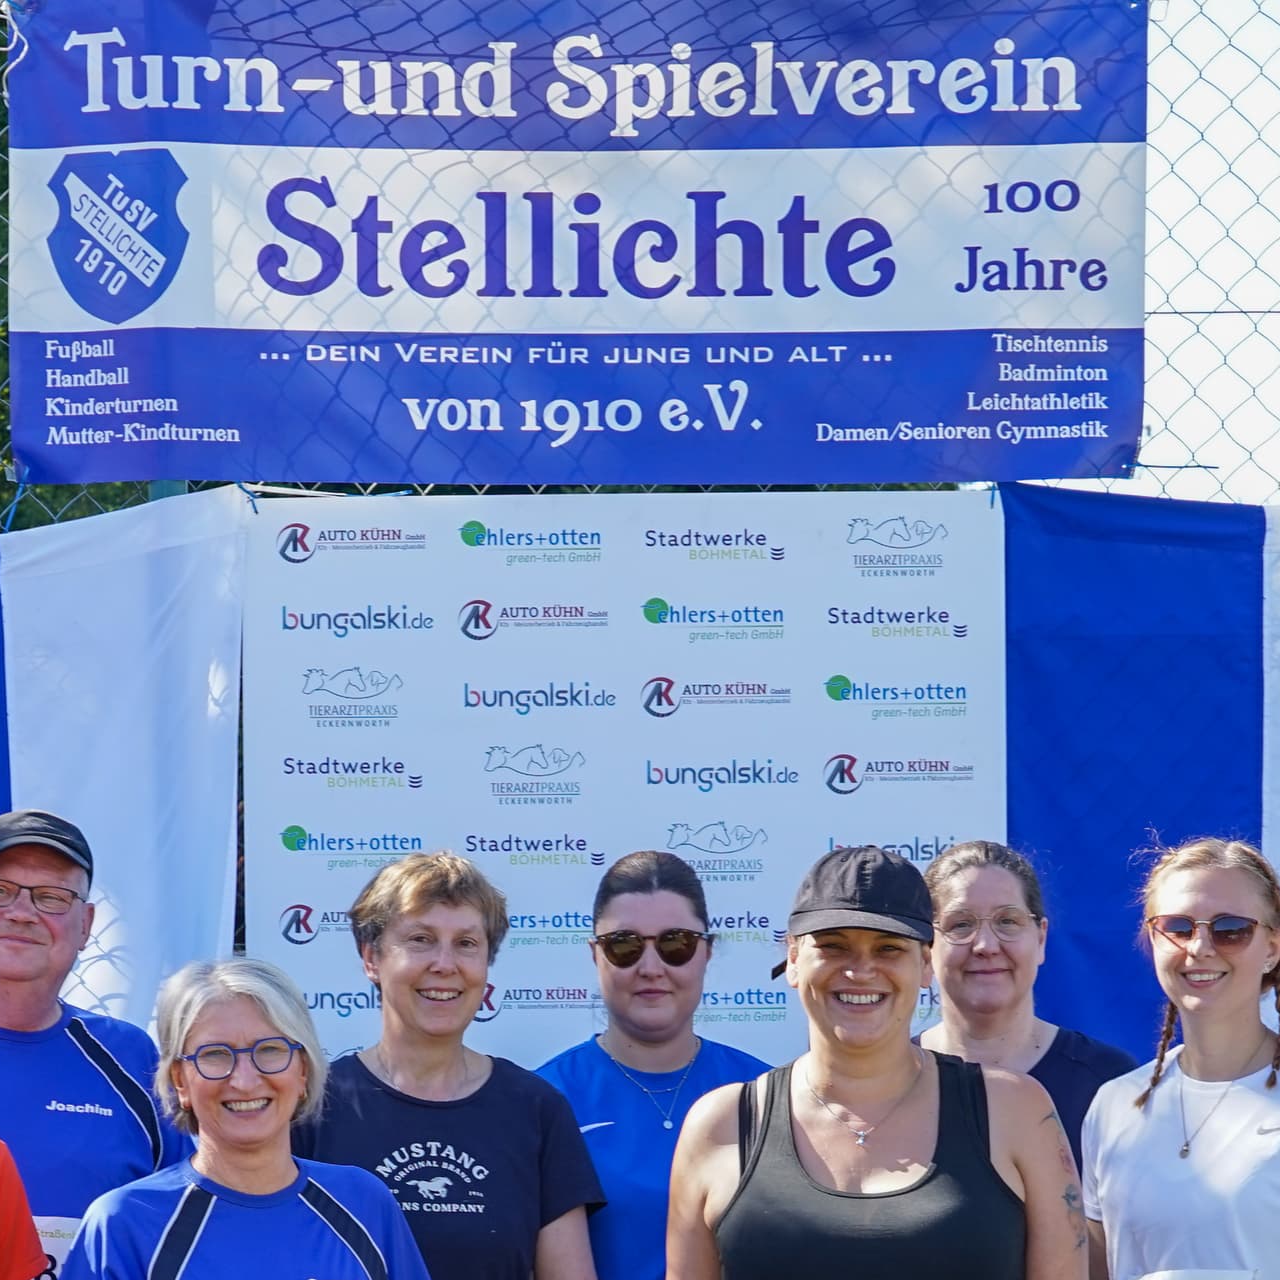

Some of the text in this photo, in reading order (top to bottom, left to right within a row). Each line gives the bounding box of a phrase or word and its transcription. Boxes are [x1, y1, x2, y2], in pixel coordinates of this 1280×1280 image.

[64, 27, 1082, 137] Turn-und Spielverein
[102, 173, 159, 232] TuSV
[983, 179, 1081, 214] 100
[73, 193, 160, 280] STELLICHTE
[257, 176, 897, 298] Stellichte
[74, 238, 128, 296] 1910
[954, 246, 1108, 293] Jahre
[45, 339, 115, 361] Fußball
[306, 344, 380, 362] DEIN
[395, 343, 512, 363] VEREIN
[528, 341, 589, 364] FÜR
[603, 347, 690, 364] JUNG
[706, 347, 774, 363] UND
[788, 346, 847, 362] ALT
[992, 334, 1108, 353] Tischtennis
[45, 367, 129, 388] Handball
[998, 362, 1108, 382] Badminton
[45, 396, 178, 417] Kinderturnen
[967, 392, 1108, 412] Leichtathletik
[402, 380, 762, 448] von 1910 e.V.
[46, 422, 240, 445] Mutter-Kindturnen
[816, 421, 1108, 445] Damen/Senioren Gymnastik
[318, 529, 357, 541] AUTO
[360, 528, 402, 540] KÜHN
[645, 528, 767, 547] Stadtwerke
[853, 554, 943, 565] TIERARZTPRAXIS
[282, 605, 434, 637] bungalski.de
[500, 607, 539, 618] AUTO
[542, 605, 584, 617] KÜHN
[828, 606, 950, 624] Stadtwerke
[464, 682, 616, 715] bungalski.de
[683, 684, 722, 696] AUTO
[725, 682, 767, 695] KÜHN
[309, 704, 397, 715] TIERARZTPRAXIS
[283, 756, 405, 775] Stadtwerke
[647, 759, 799, 792] bungalski.de
[865, 761, 904, 772] AUTO
[907, 759, 950, 772] KÜHN
[491, 782, 580, 793] TIERARZTPRAXIS
[465, 834, 587, 852] Stadtwerke
[321, 911, 348, 922] AUT
[708, 911, 769, 928] werke
[503, 989, 542, 1000] AUTO
[545, 987, 587, 1000] KÜHN
[46, 1100, 113, 1116] Joachim
[375, 1141, 490, 1180] MUSTANG
[393, 1160, 472, 1183] ORIGINAL BRAND
[422, 1203, 485, 1213] COMPANY
